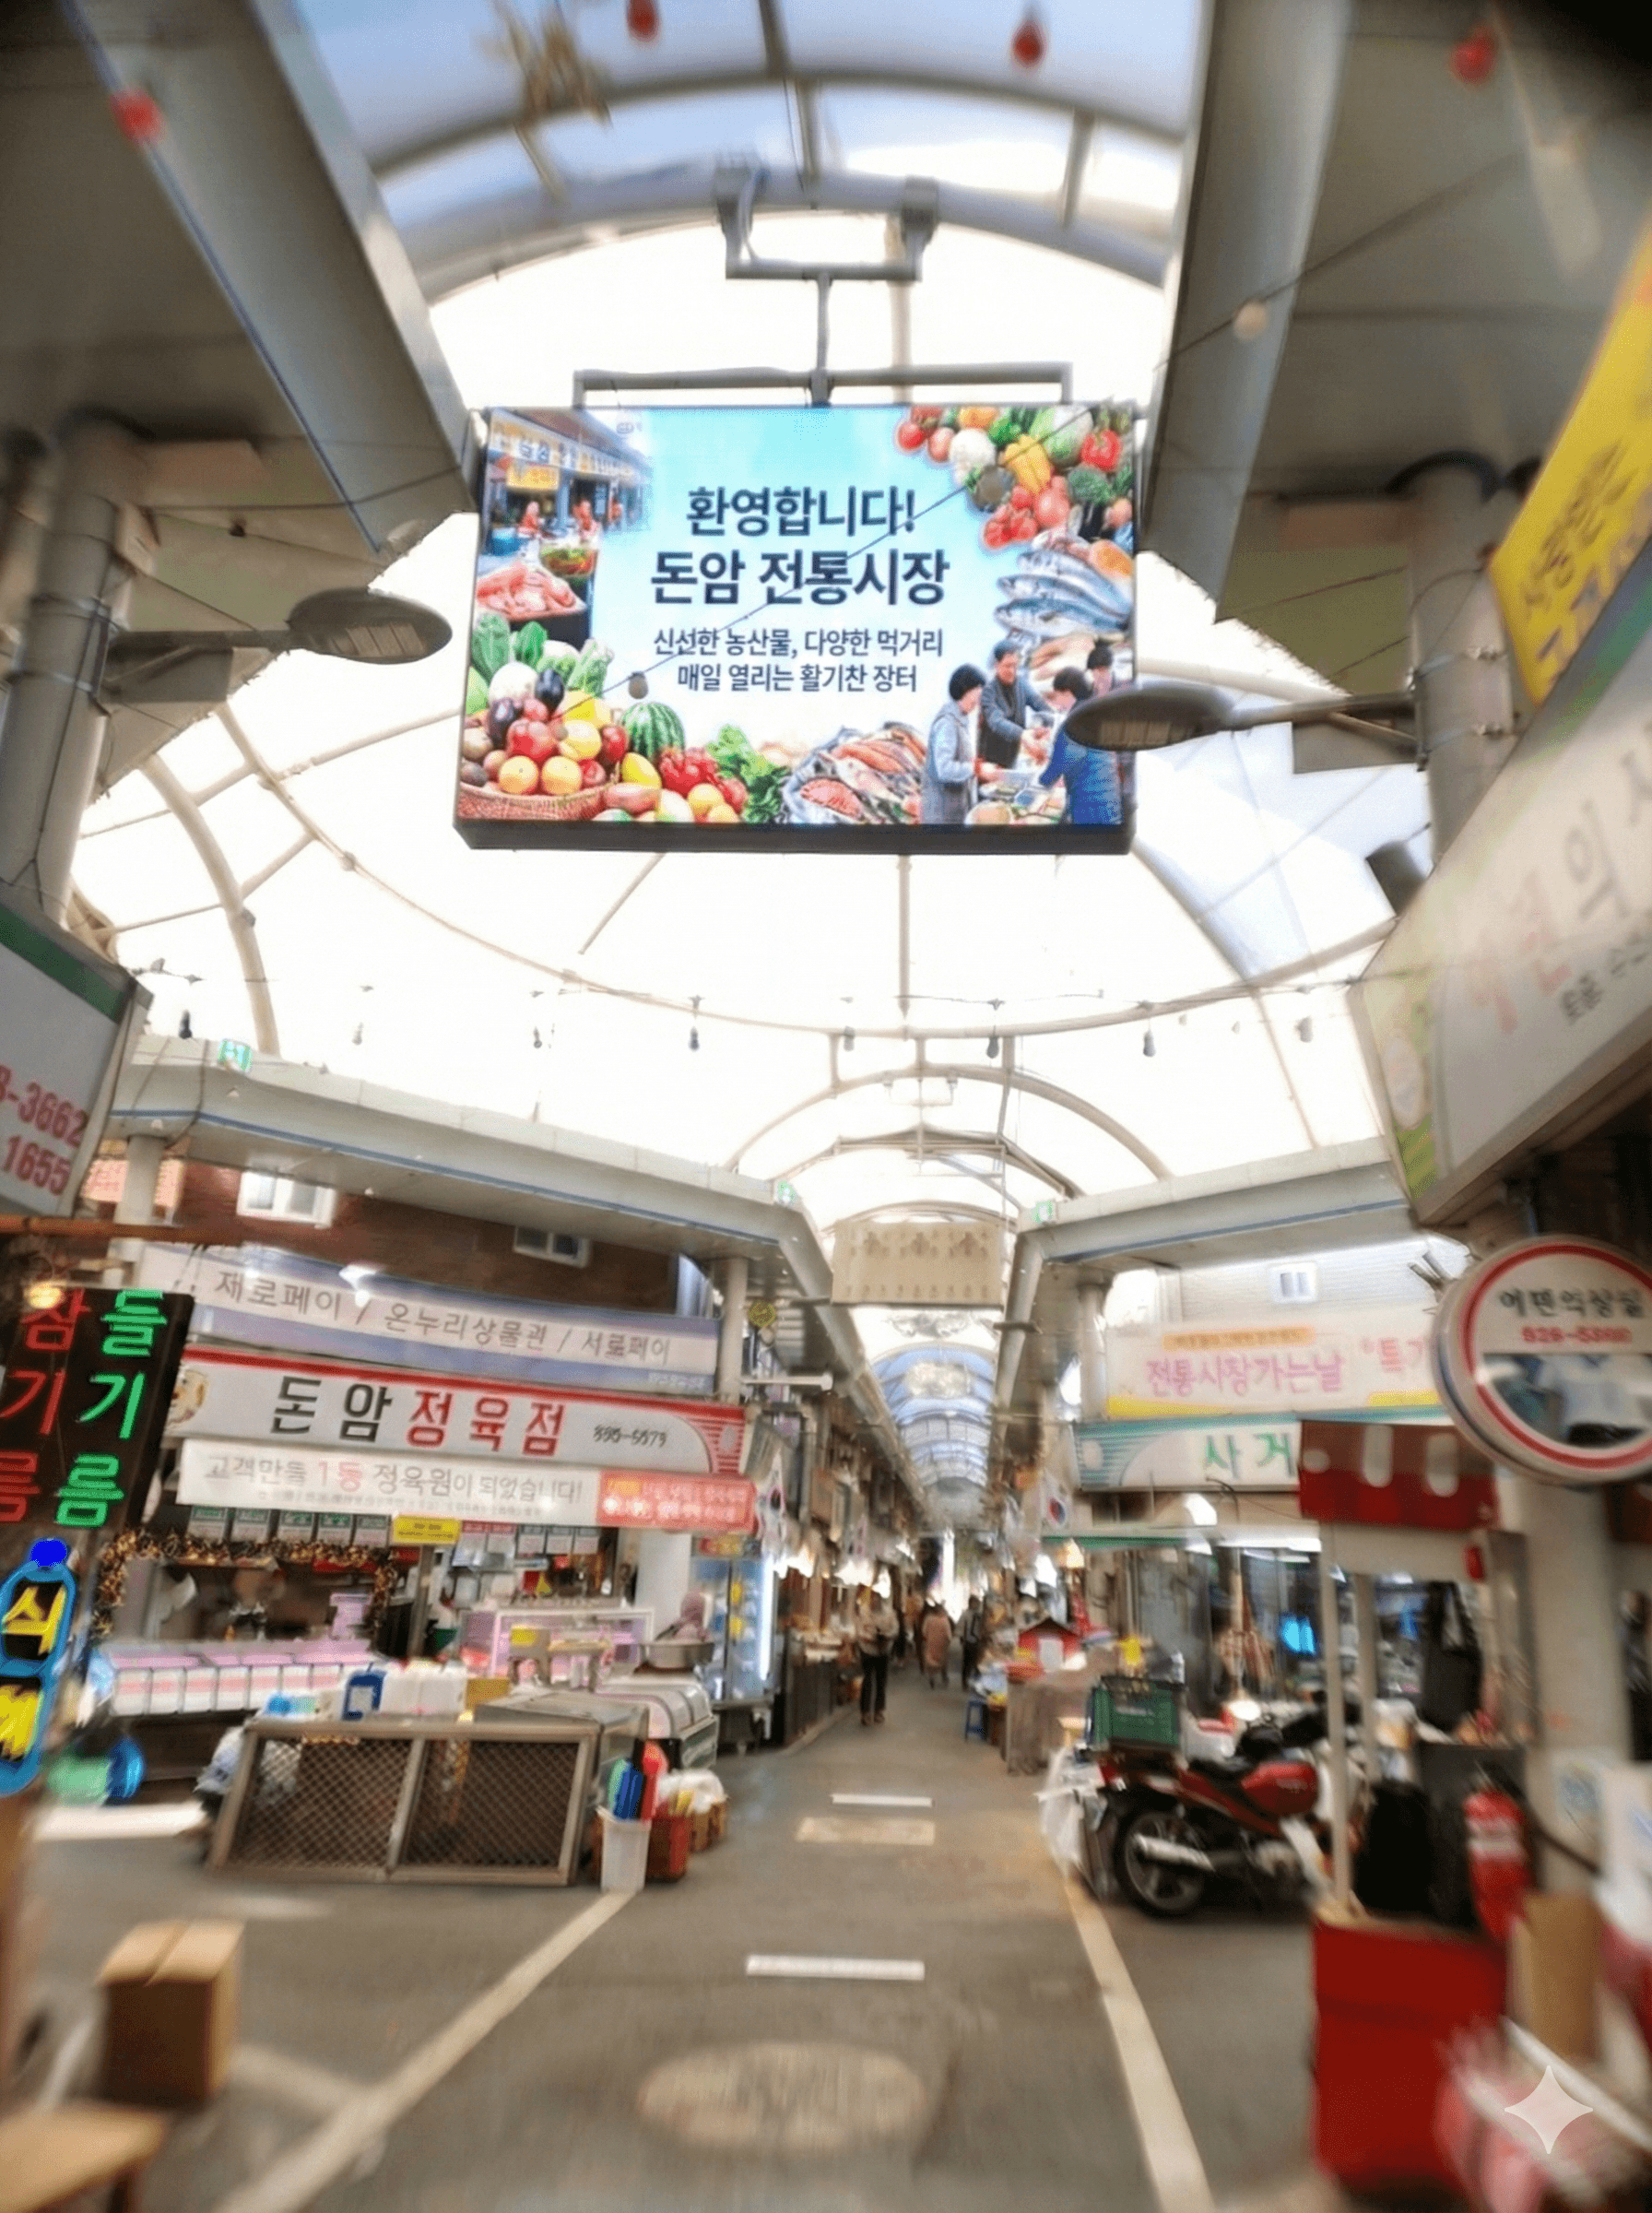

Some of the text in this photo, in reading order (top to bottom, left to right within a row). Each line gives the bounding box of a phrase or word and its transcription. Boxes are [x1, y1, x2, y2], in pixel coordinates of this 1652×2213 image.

[687, 485, 917, 538] 환영합니다!
[650, 550, 950, 605] 돈암 전통시장
[653, 627, 944, 660] 신선한 농산물, 다양한 먹거리
[677, 664, 918, 693] 매일 열리는 활기찬 장터
[3, 1135, 72, 1196] 1655
[213, 1270, 342, 1321] 제로페이
[271, 1375, 393, 1443] 돈암
[407, 1390, 568, 1457] 정육점
